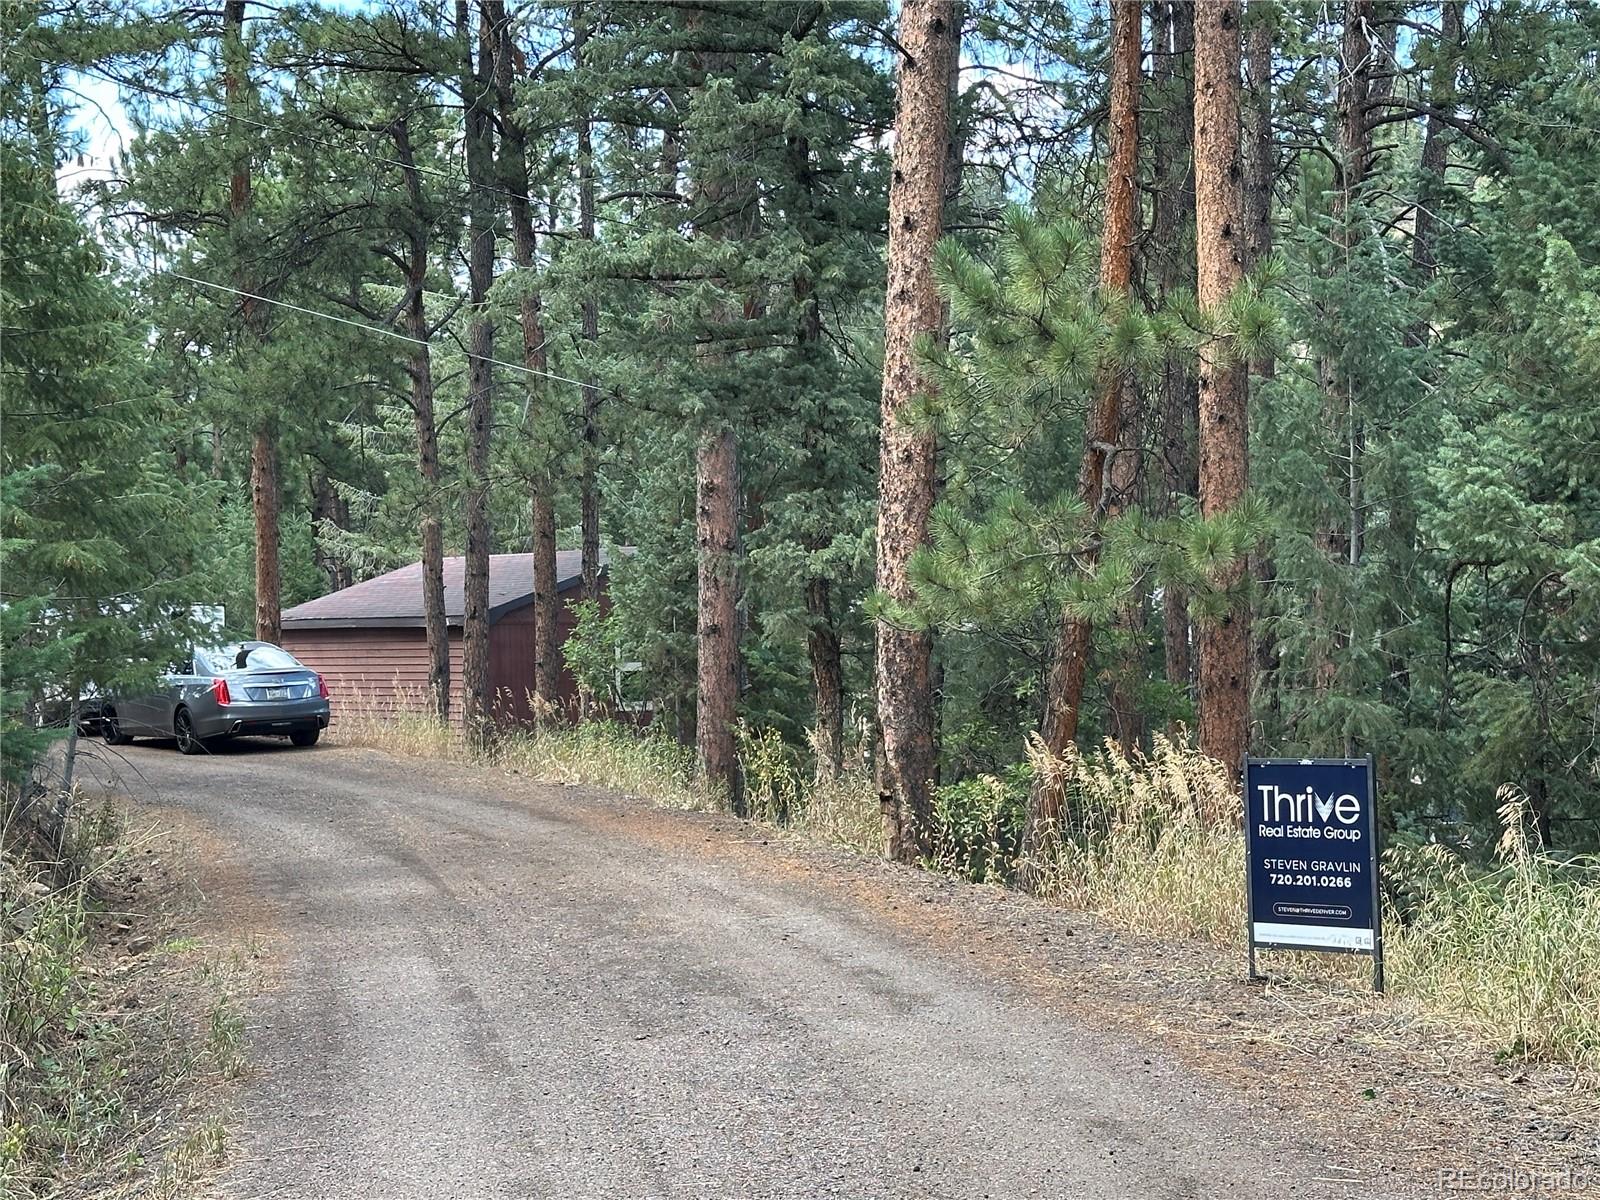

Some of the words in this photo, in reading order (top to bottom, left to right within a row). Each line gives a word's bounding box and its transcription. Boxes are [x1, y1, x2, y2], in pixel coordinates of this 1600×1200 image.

[1257, 785, 1360, 825] Thrive
[1258, 825, 1284, 838] Real
[1287, 826, 1321, 839] Estate
[1323, 827, 1361, 842] Group
[1263, 858, 1307, 871] STEVEN
[1311, 860, 1361, 873] GRAVLIN
[1269, 873, 1352, 888] 720.201.0266
[1277, 906, 1347, 916] STEVEN@THRIVEDENVER.COM
